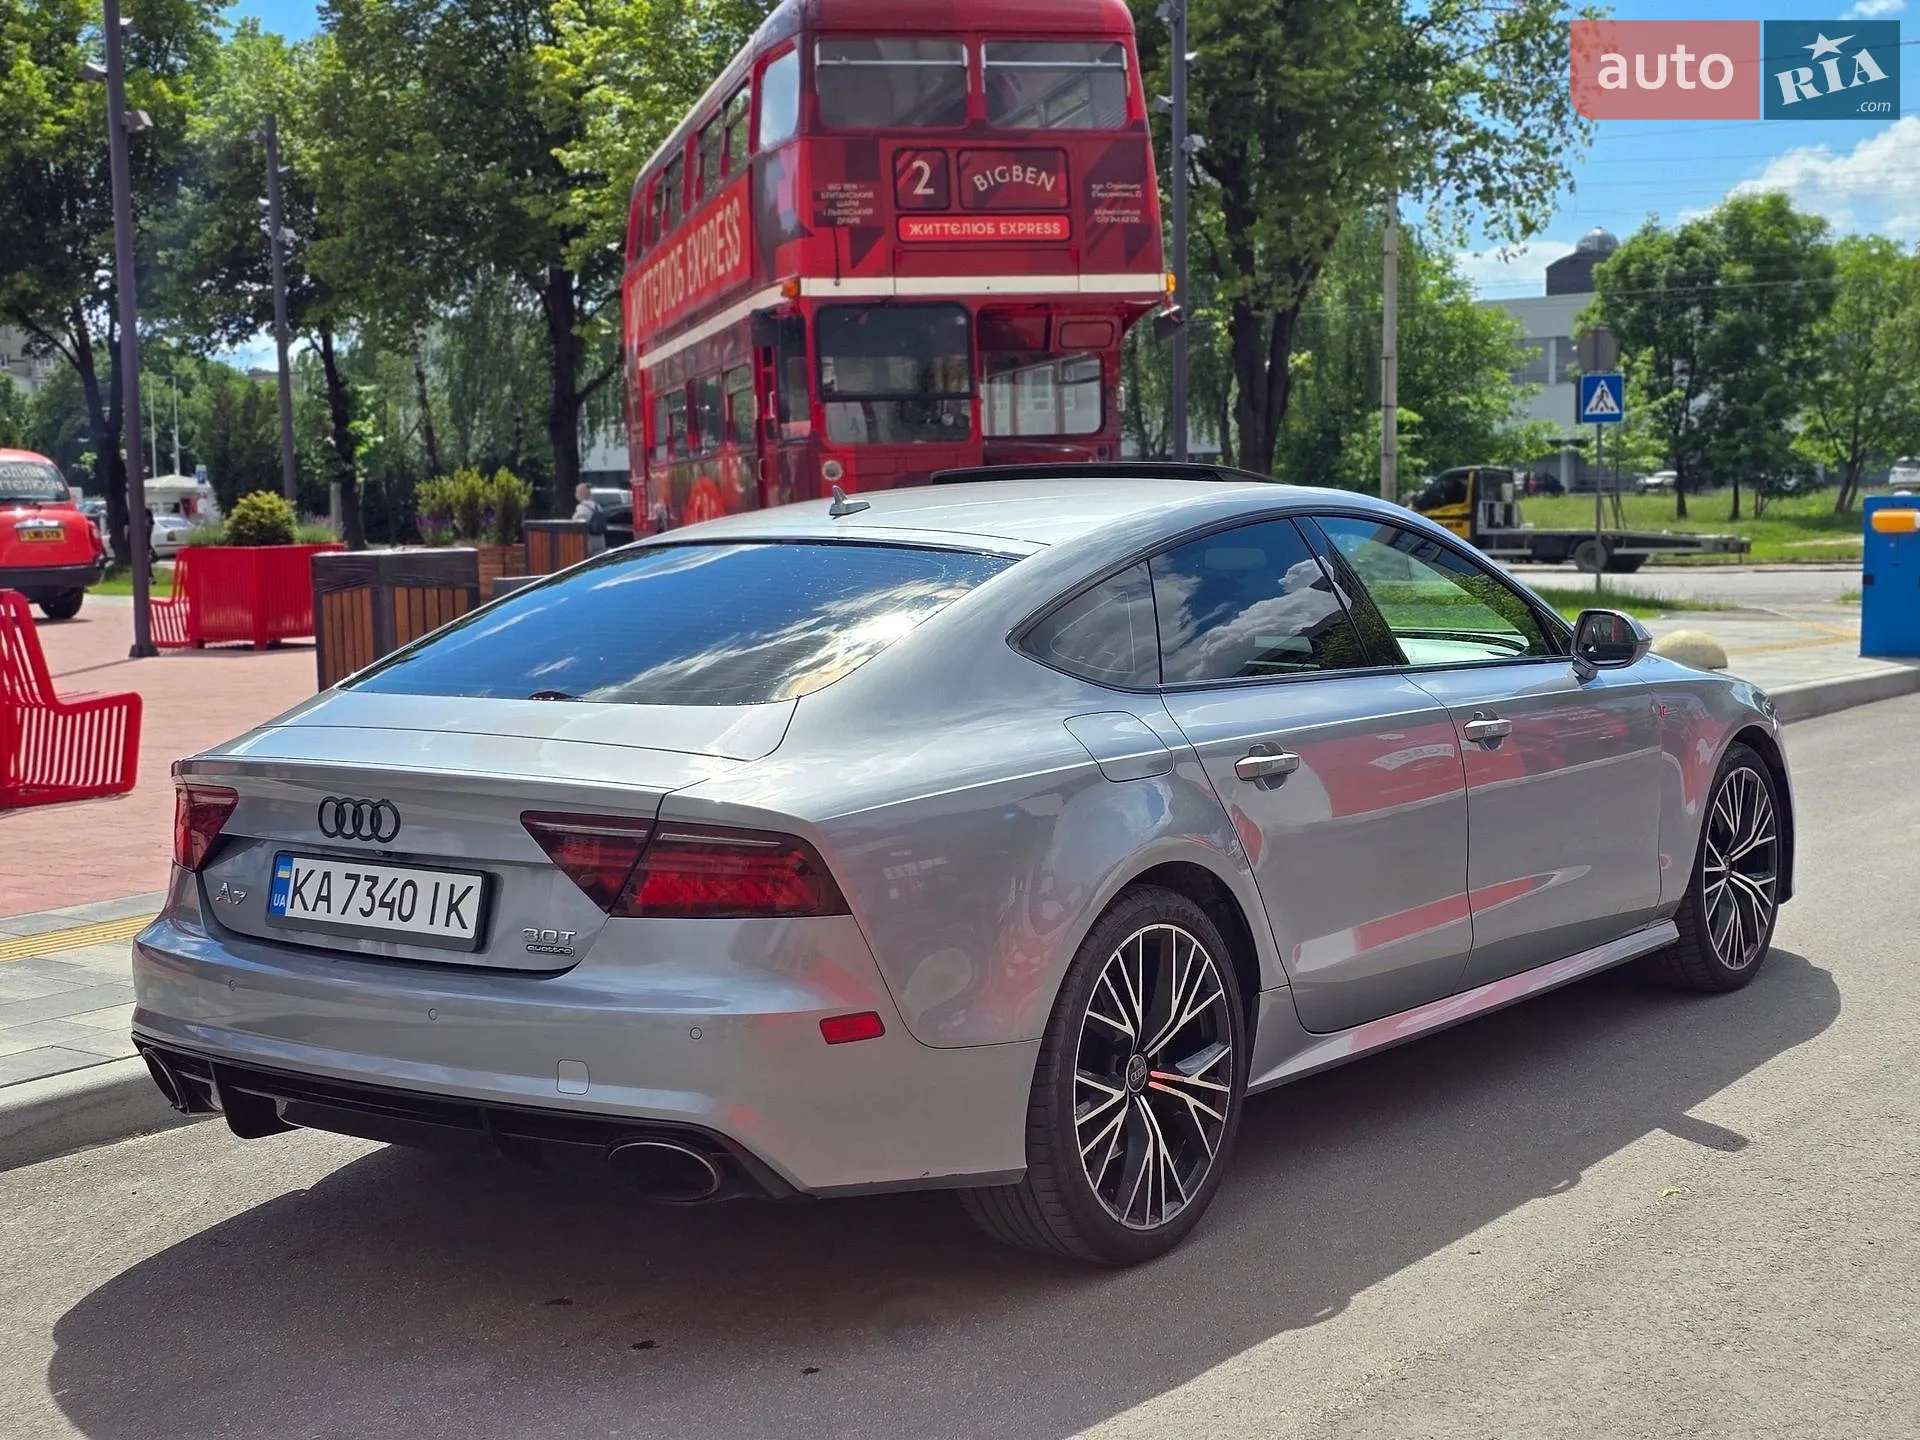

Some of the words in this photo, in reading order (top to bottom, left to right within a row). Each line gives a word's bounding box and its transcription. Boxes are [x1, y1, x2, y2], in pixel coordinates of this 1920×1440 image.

[912, 159, 935, 195] 2
[972, 164, 1056, 192] BIGBEN
[1000, 222, 1062, 235] EXPRESS
[686, 197, 741, 296] EXPRESS
[216, 882, 248, 905] A7
[273, 892, 287, 909] UA
[289, 867, 332, 914] KA
[340, 872, 419, 923] 7340
[428, 881, 475, 930] IK
